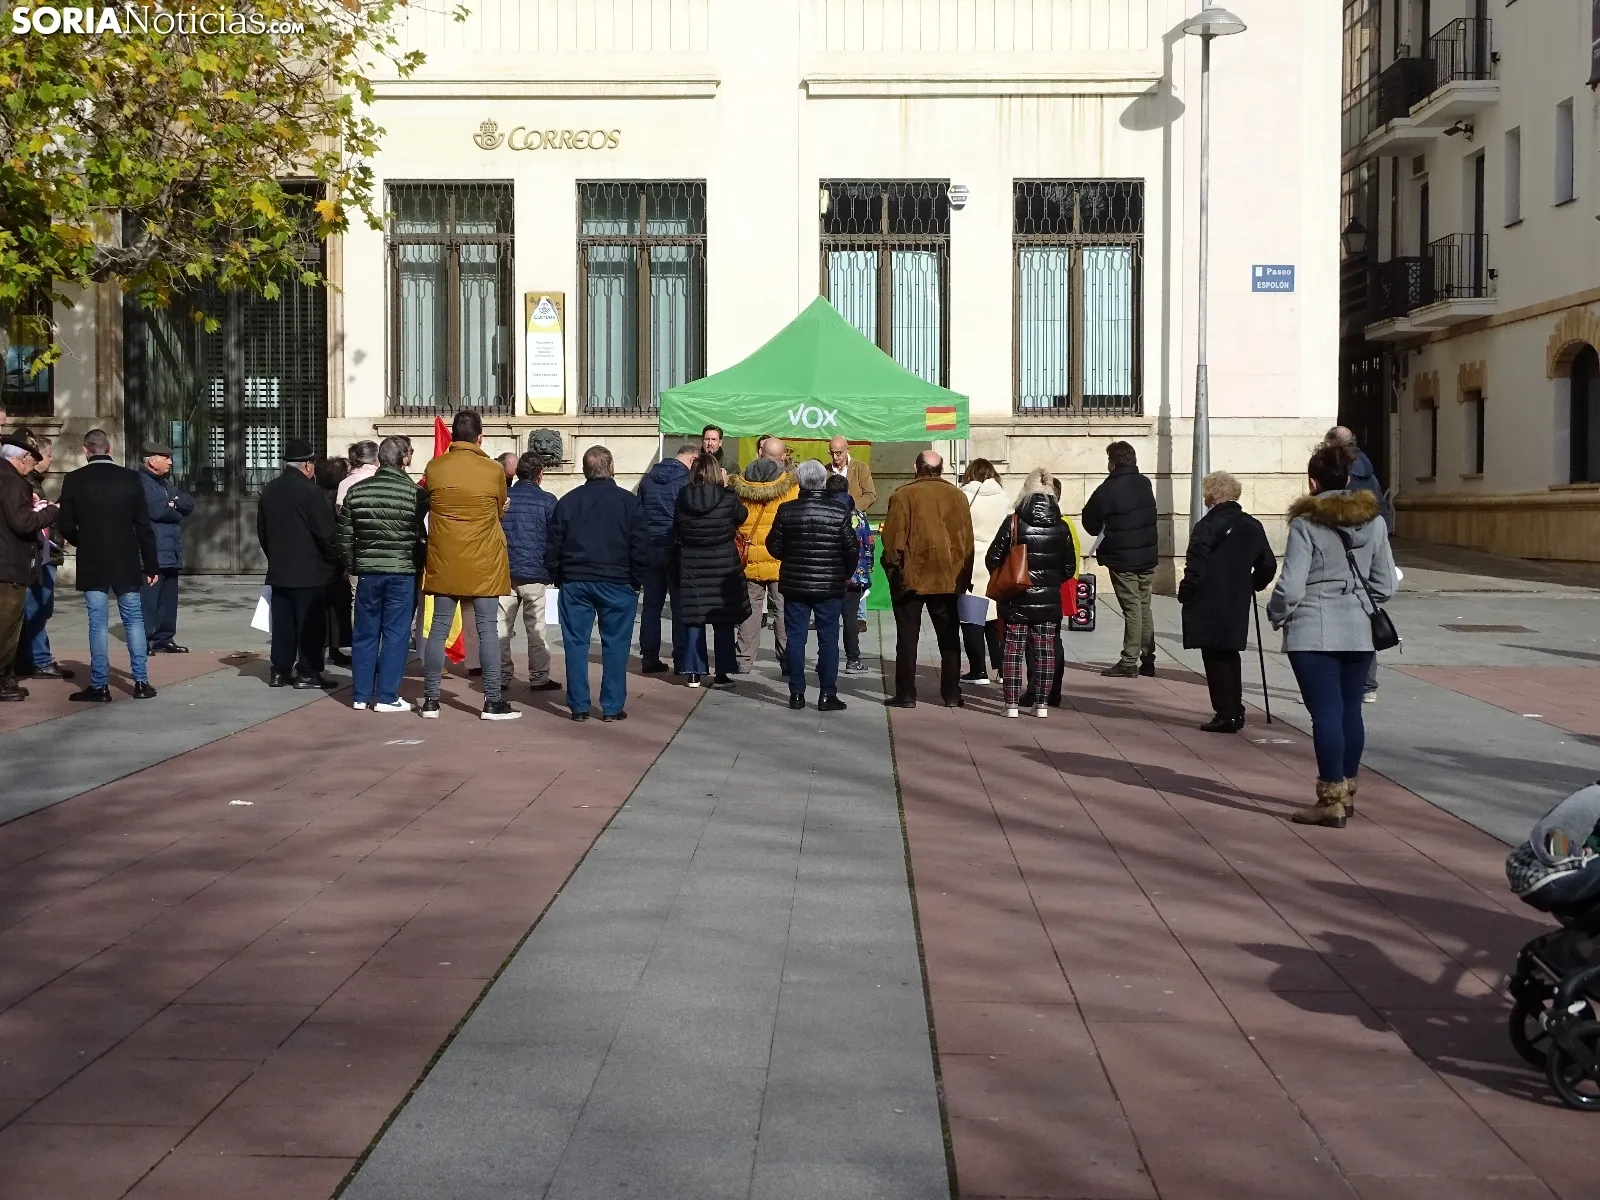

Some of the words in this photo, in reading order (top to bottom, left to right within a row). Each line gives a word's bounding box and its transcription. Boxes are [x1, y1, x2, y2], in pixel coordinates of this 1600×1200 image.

[1266, 267, 1291, 276] Paseo
[1257, 280, 1289, 289] ESPOLÓN
[788, 403, 838, 429] VOX
